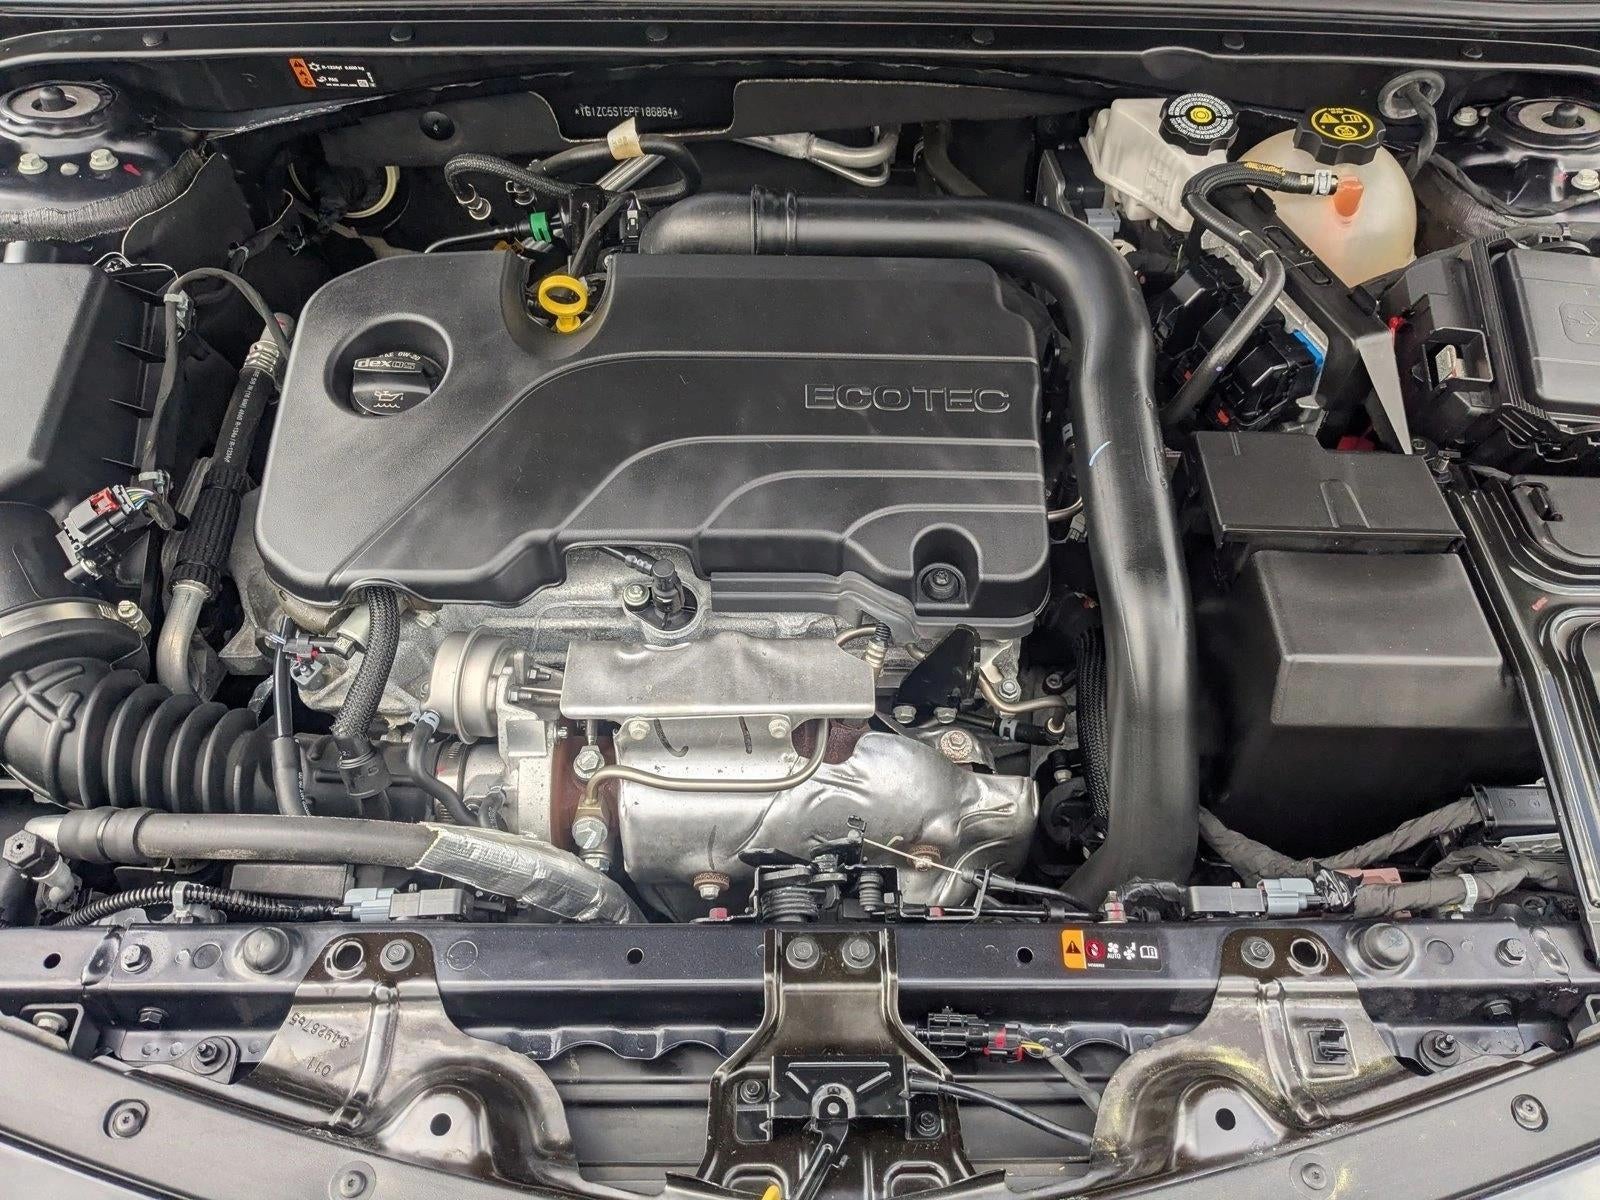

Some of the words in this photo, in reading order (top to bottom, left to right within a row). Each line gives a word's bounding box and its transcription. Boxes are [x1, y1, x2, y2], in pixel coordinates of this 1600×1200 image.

[357, 358, 416, 370] dexos
[804, 383, 1011, 414] ECOTEC
[1106, 952, 1121, 960] AUTO
